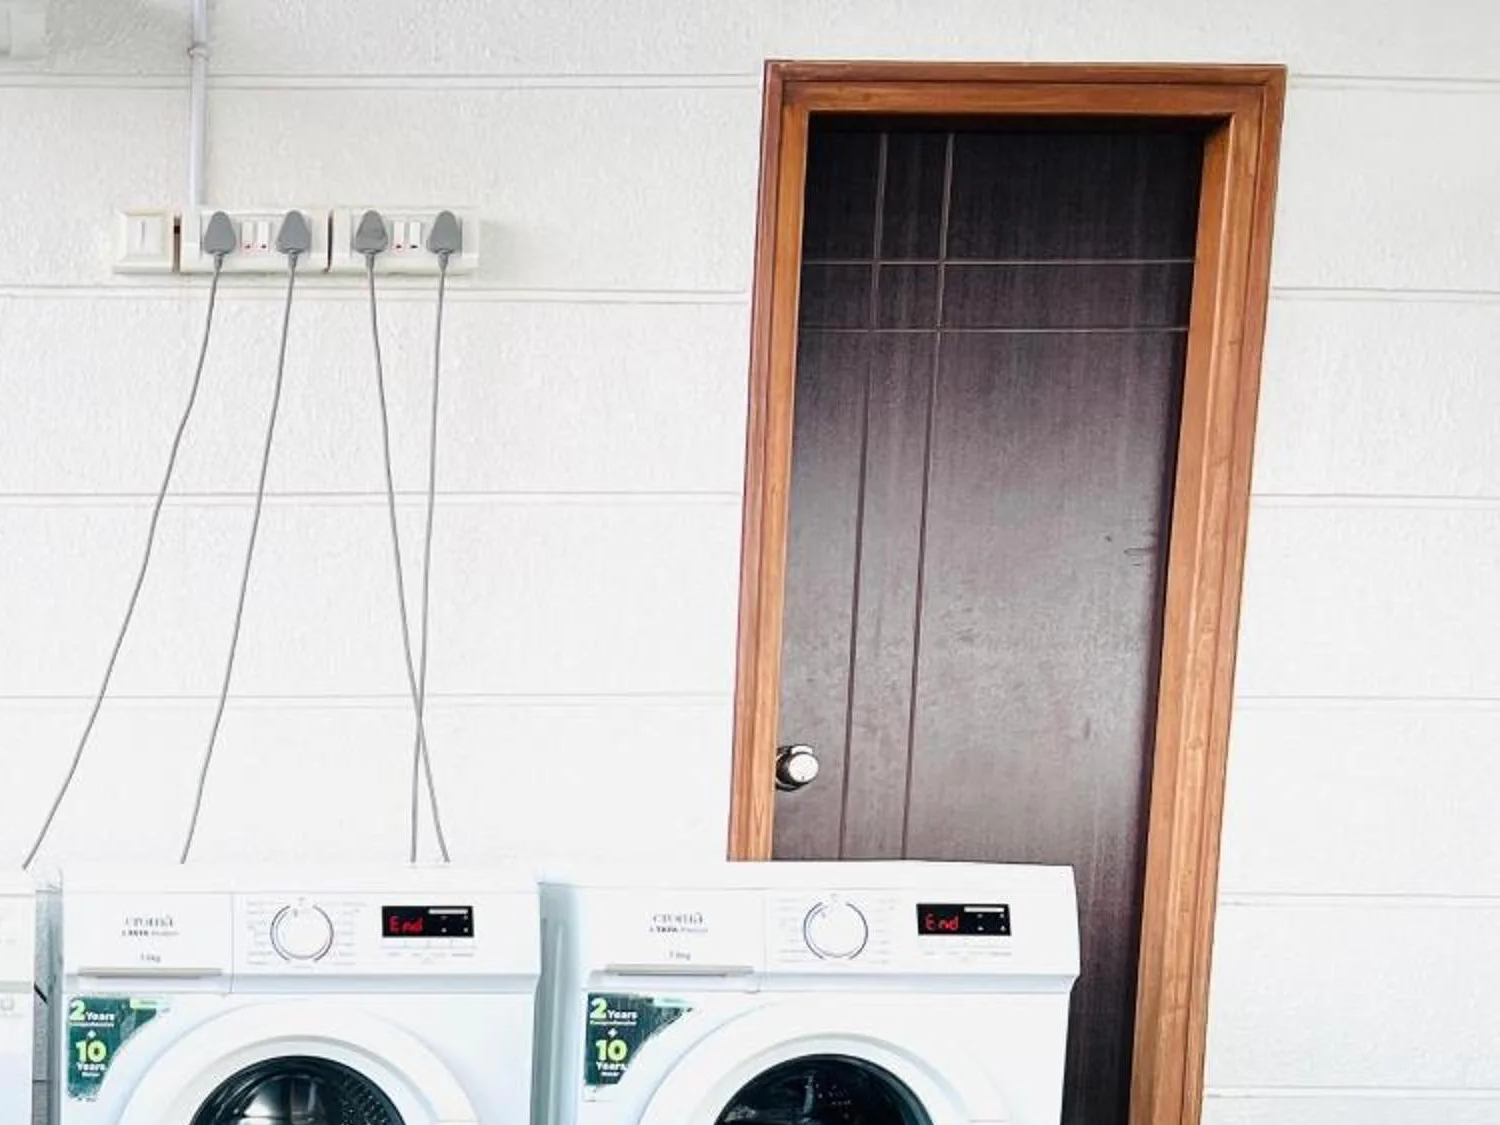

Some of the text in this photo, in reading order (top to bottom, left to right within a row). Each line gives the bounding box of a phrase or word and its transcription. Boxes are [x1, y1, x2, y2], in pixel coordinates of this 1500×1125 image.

[389, 915, 423, 933] End
[926, 913, 959, 930] End
[69, 999, 115, 1021] 2 Years
[589, 997, 638, 1019] 2 Years
[75, 1039, 107, 1062] 10
[595, 1039, 628, 1061] 10
[76, 1062, 106, 1071] Years
[596, 1061, 627, 1071] Years
